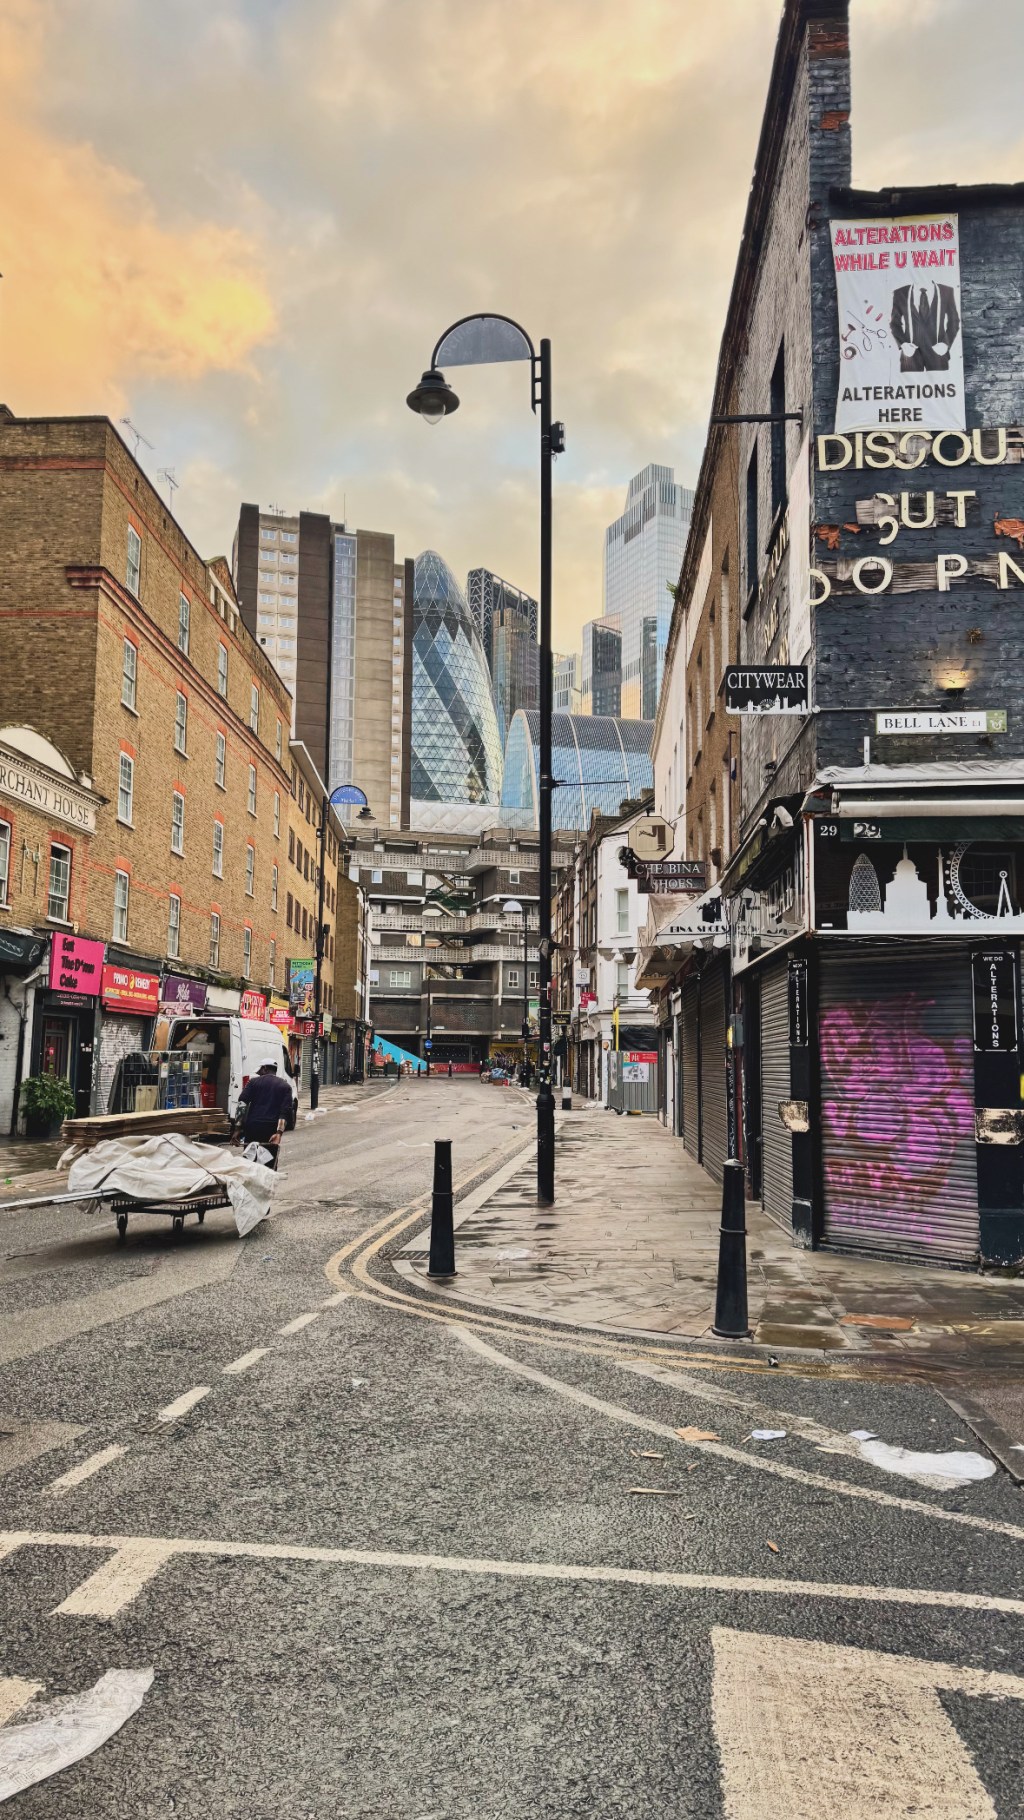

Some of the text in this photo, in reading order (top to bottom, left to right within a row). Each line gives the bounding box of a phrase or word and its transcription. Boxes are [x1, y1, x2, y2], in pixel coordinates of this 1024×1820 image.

[834, 221, 955, 247] ALTERATIONS
[834, 249, 957, 272] WHILE U WAIT
[842, 383, 956, 401] ALTERATIONS
[878, 407, 923, 422] HERE
[727, 672, 806, 690] CITYWEAR
[884, 717, 921, 729] BELL
[929, 716, 968, 728] LANE
[53, 792, 89, 825] HOUSE
[820, 825, 838, 837] 29
[669, 863, 701, 874] BINA
[650, 878, 693, 890] SHOES
[989, 963, 999, 1047] ALTERATIONS
